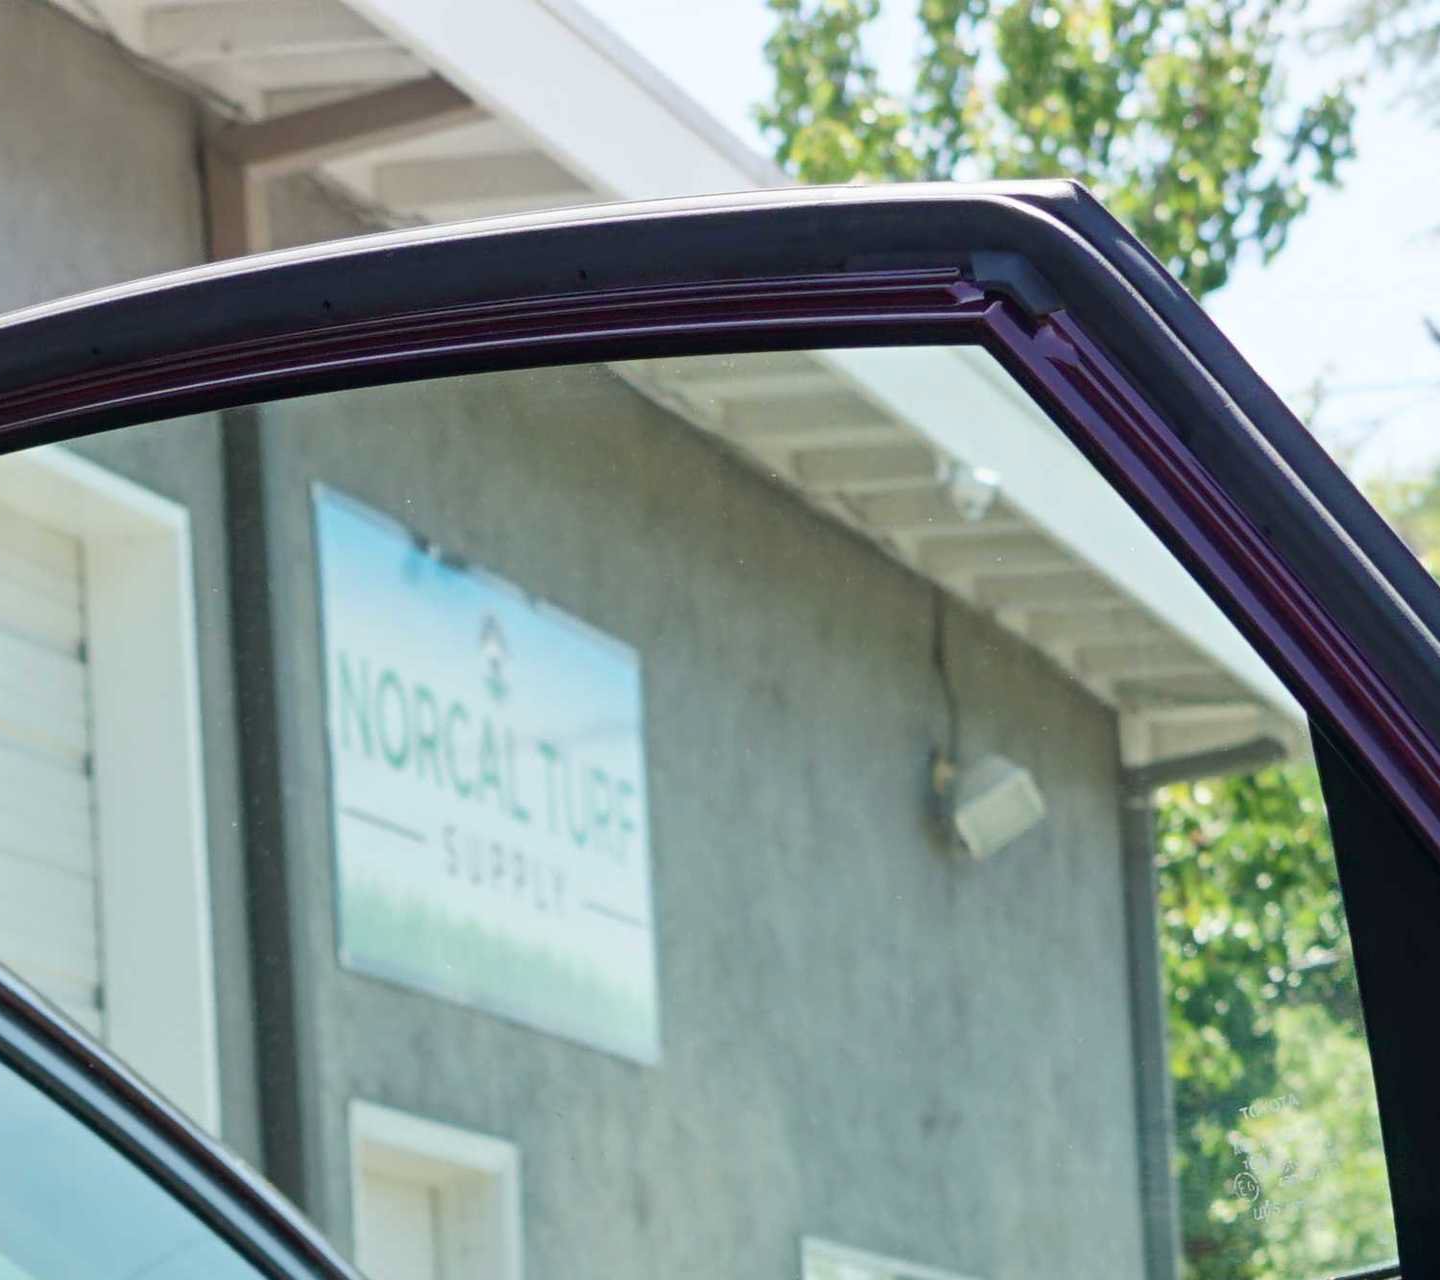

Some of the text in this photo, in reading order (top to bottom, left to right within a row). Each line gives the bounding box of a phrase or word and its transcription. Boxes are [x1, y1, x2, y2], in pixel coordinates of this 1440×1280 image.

[337, 651, 637, 863] NORCAL TURF
[442, 824, 567, 915] SUPPLY
